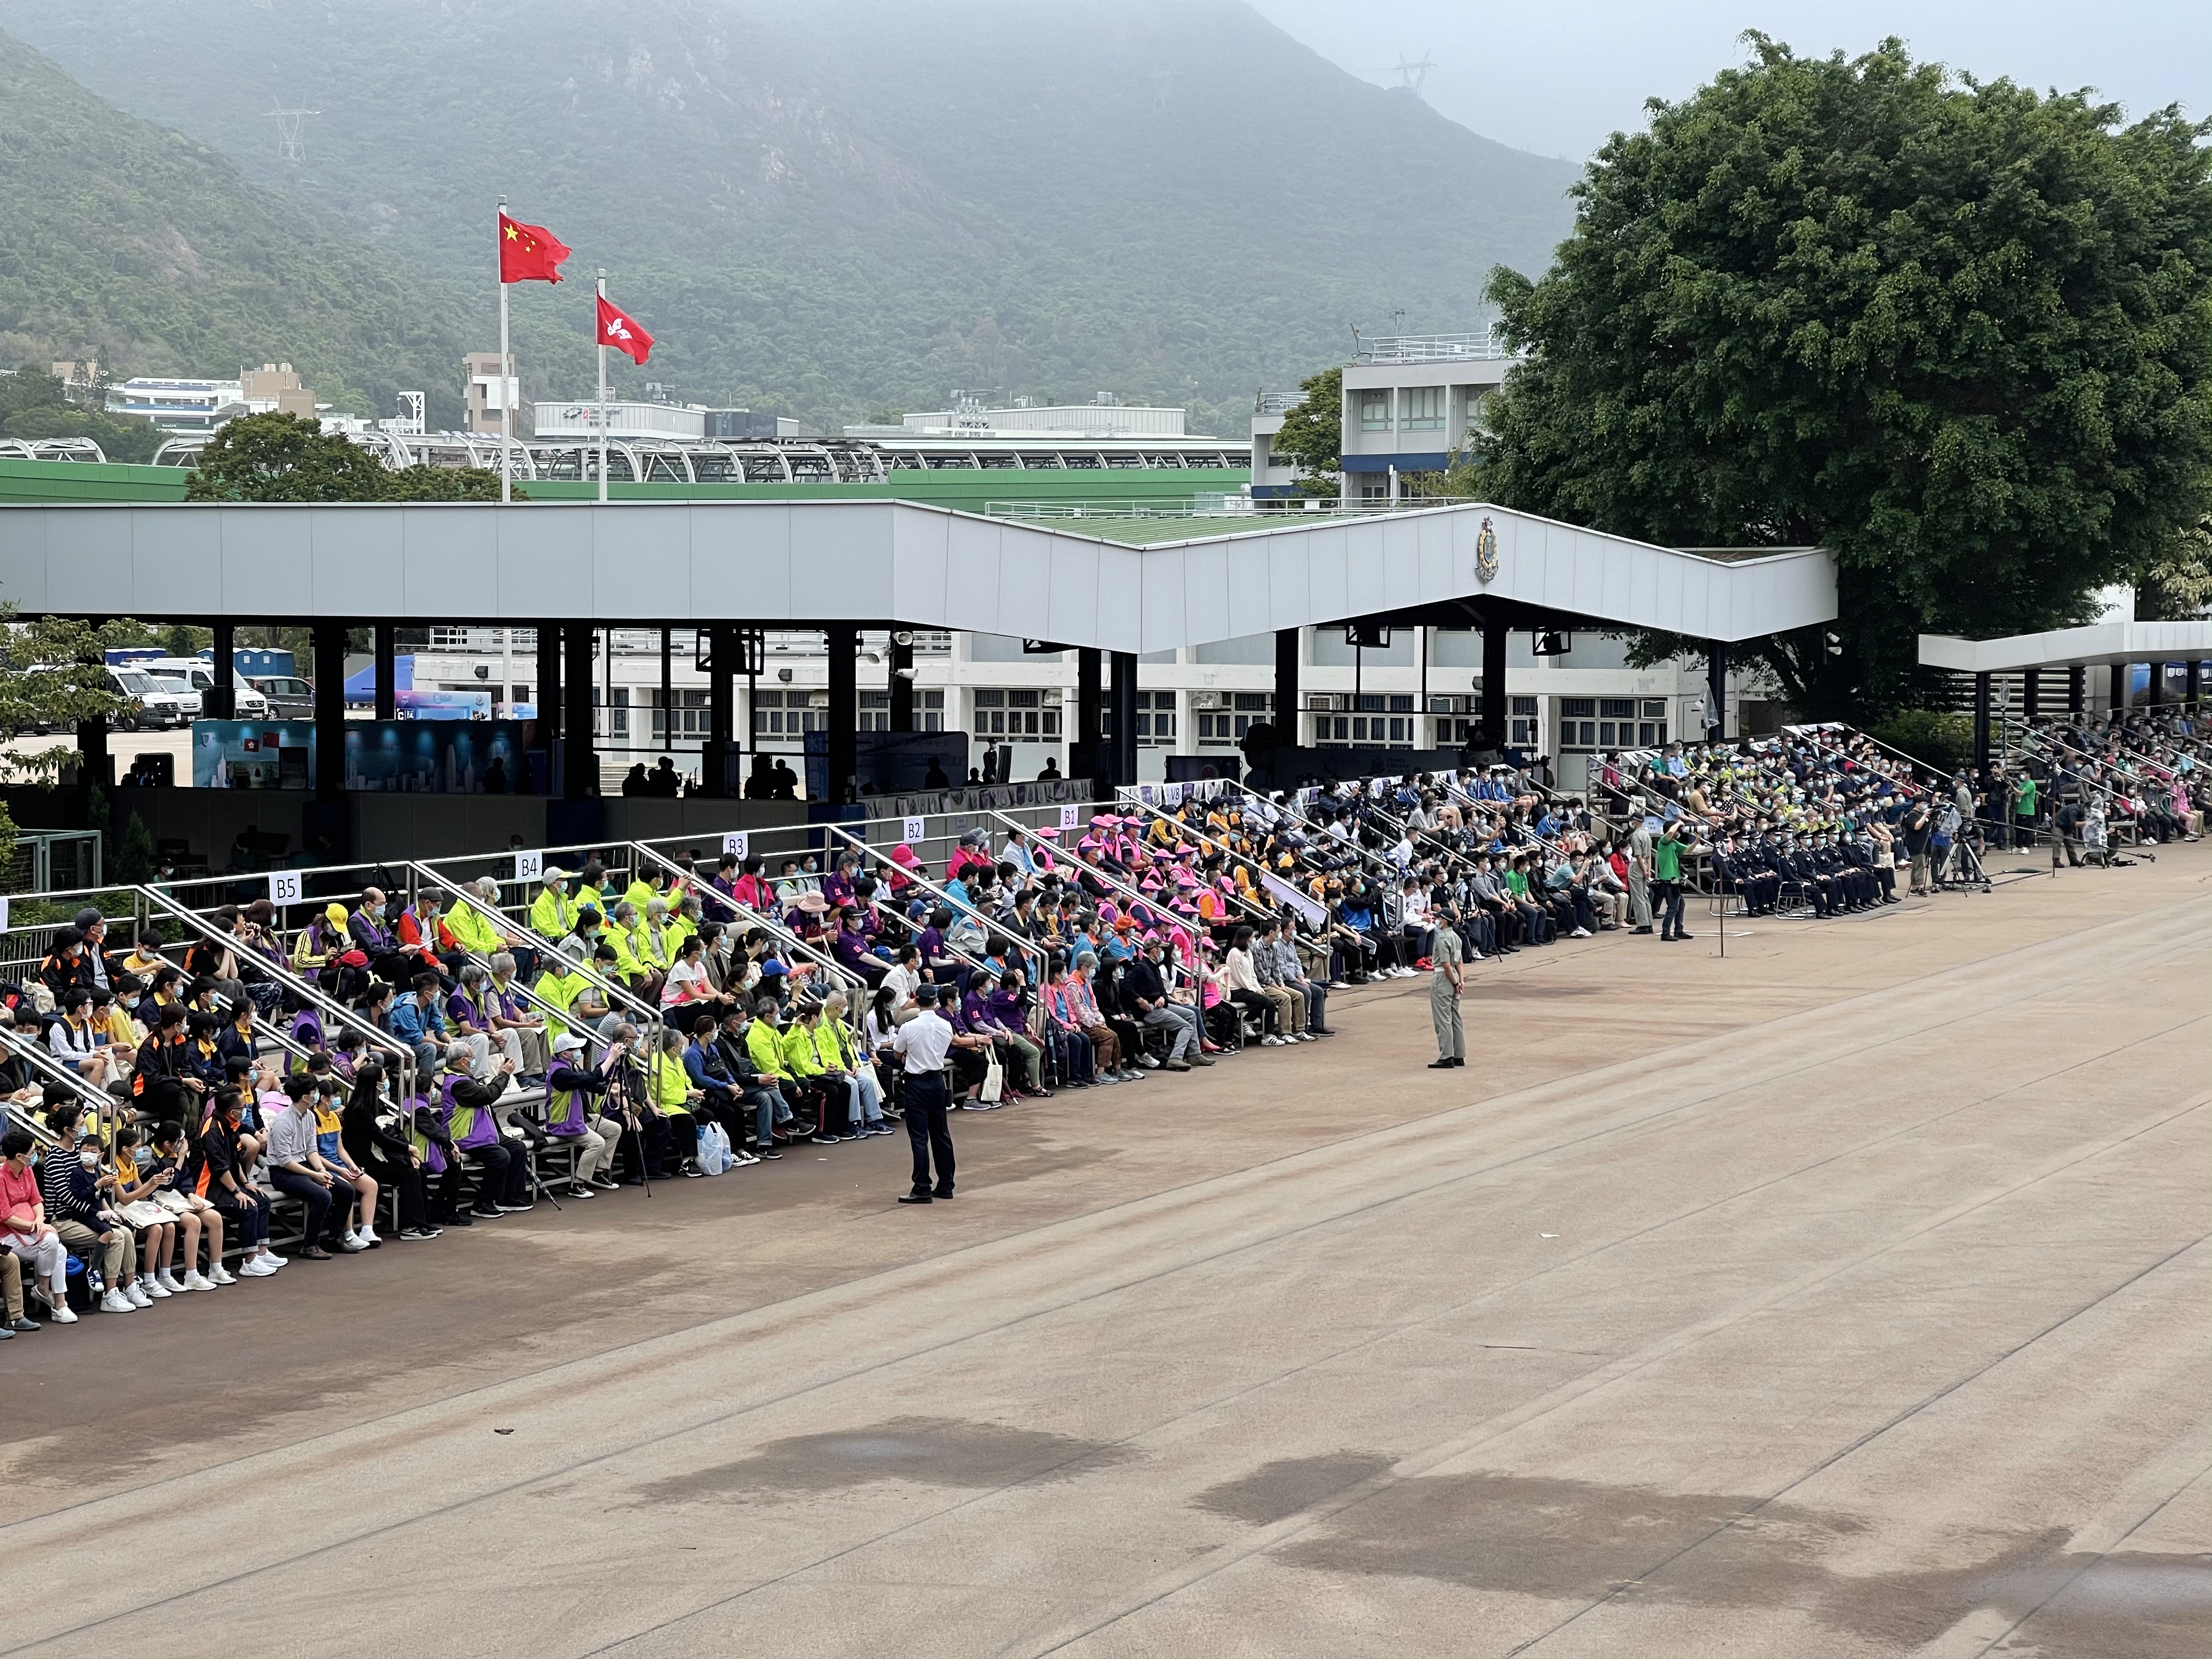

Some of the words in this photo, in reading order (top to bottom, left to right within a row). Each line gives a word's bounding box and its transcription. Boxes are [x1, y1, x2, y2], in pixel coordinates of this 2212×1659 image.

[1171, 788, 1180, 800] V8
[1065, 810, 1075, 825] B1
[909, 822, 920, 838] B2
[729, 839, 743, 854] B3
[522, 858, 538, 877] B4
[277, 878, 295, 898] B5
